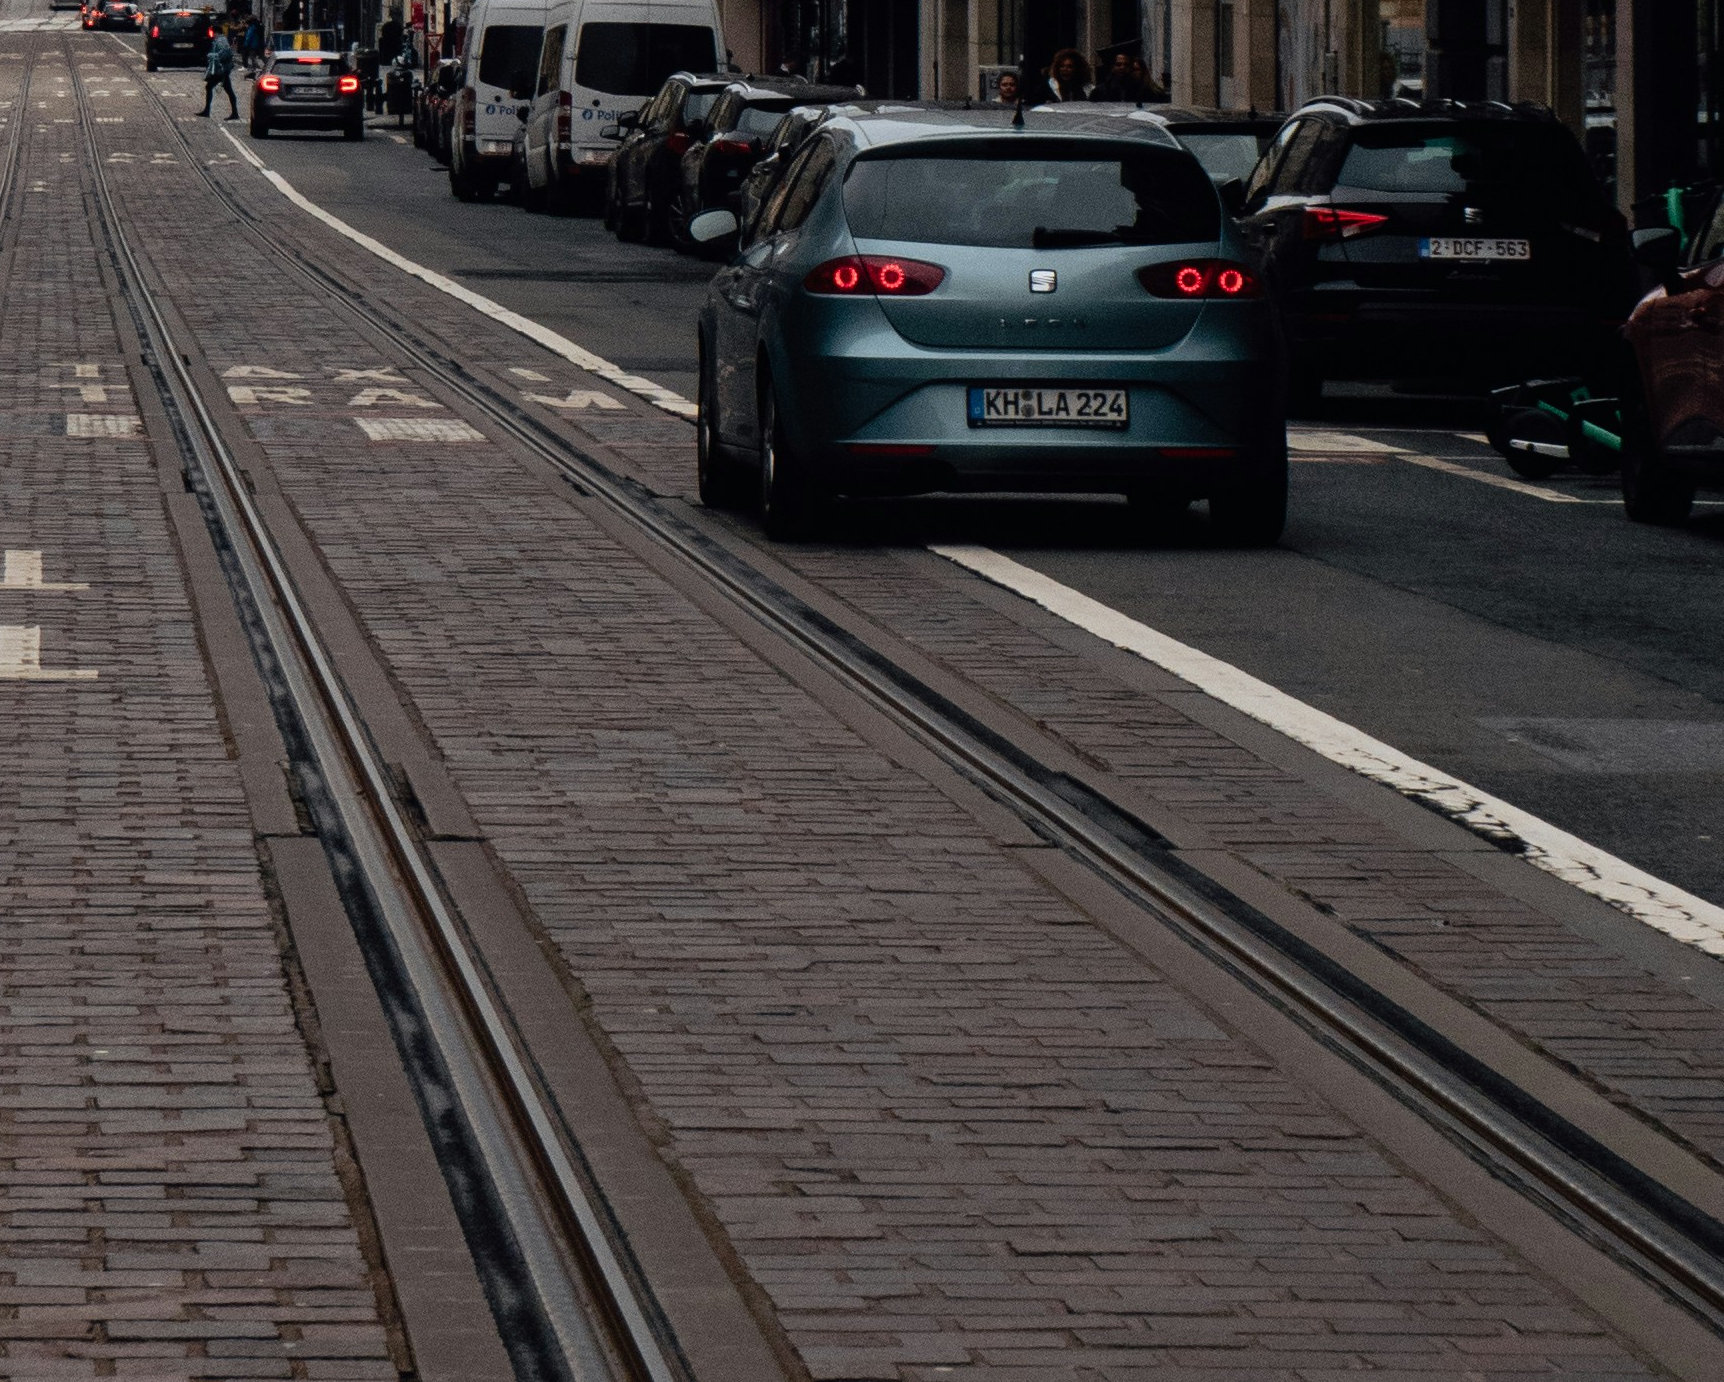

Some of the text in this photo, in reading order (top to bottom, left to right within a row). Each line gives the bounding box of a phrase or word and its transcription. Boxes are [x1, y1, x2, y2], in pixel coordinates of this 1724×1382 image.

[985, 391, 1125, 418] KH LA 224
